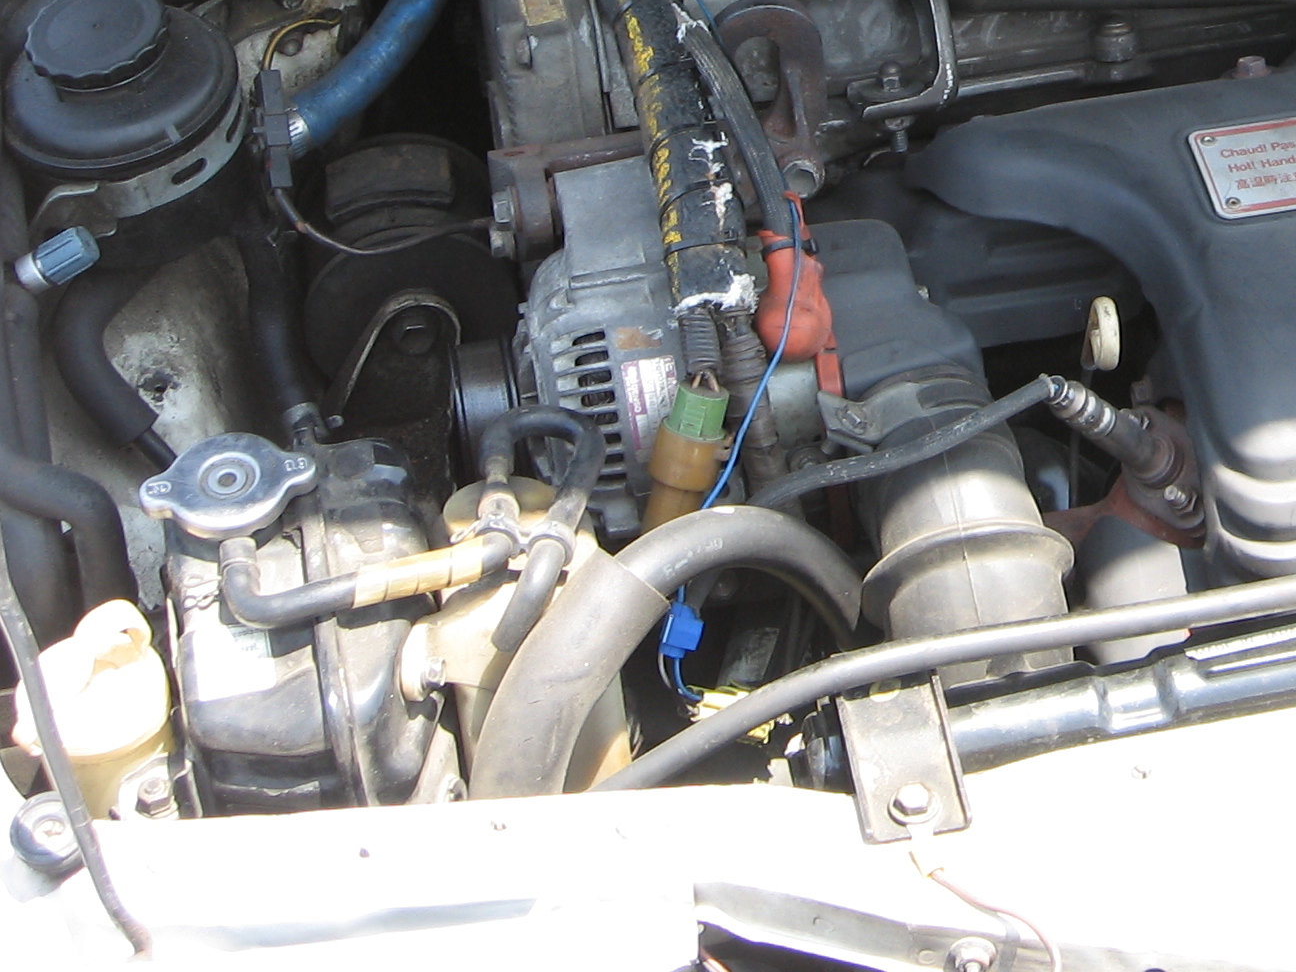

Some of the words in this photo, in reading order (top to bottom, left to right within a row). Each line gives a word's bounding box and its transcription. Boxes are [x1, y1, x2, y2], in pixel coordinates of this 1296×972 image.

[1220, 143, 1267, 159] Chaud!
[1271, 141, 1296, 151] Pas
[1228, 160, 1255, 173] Hot!
